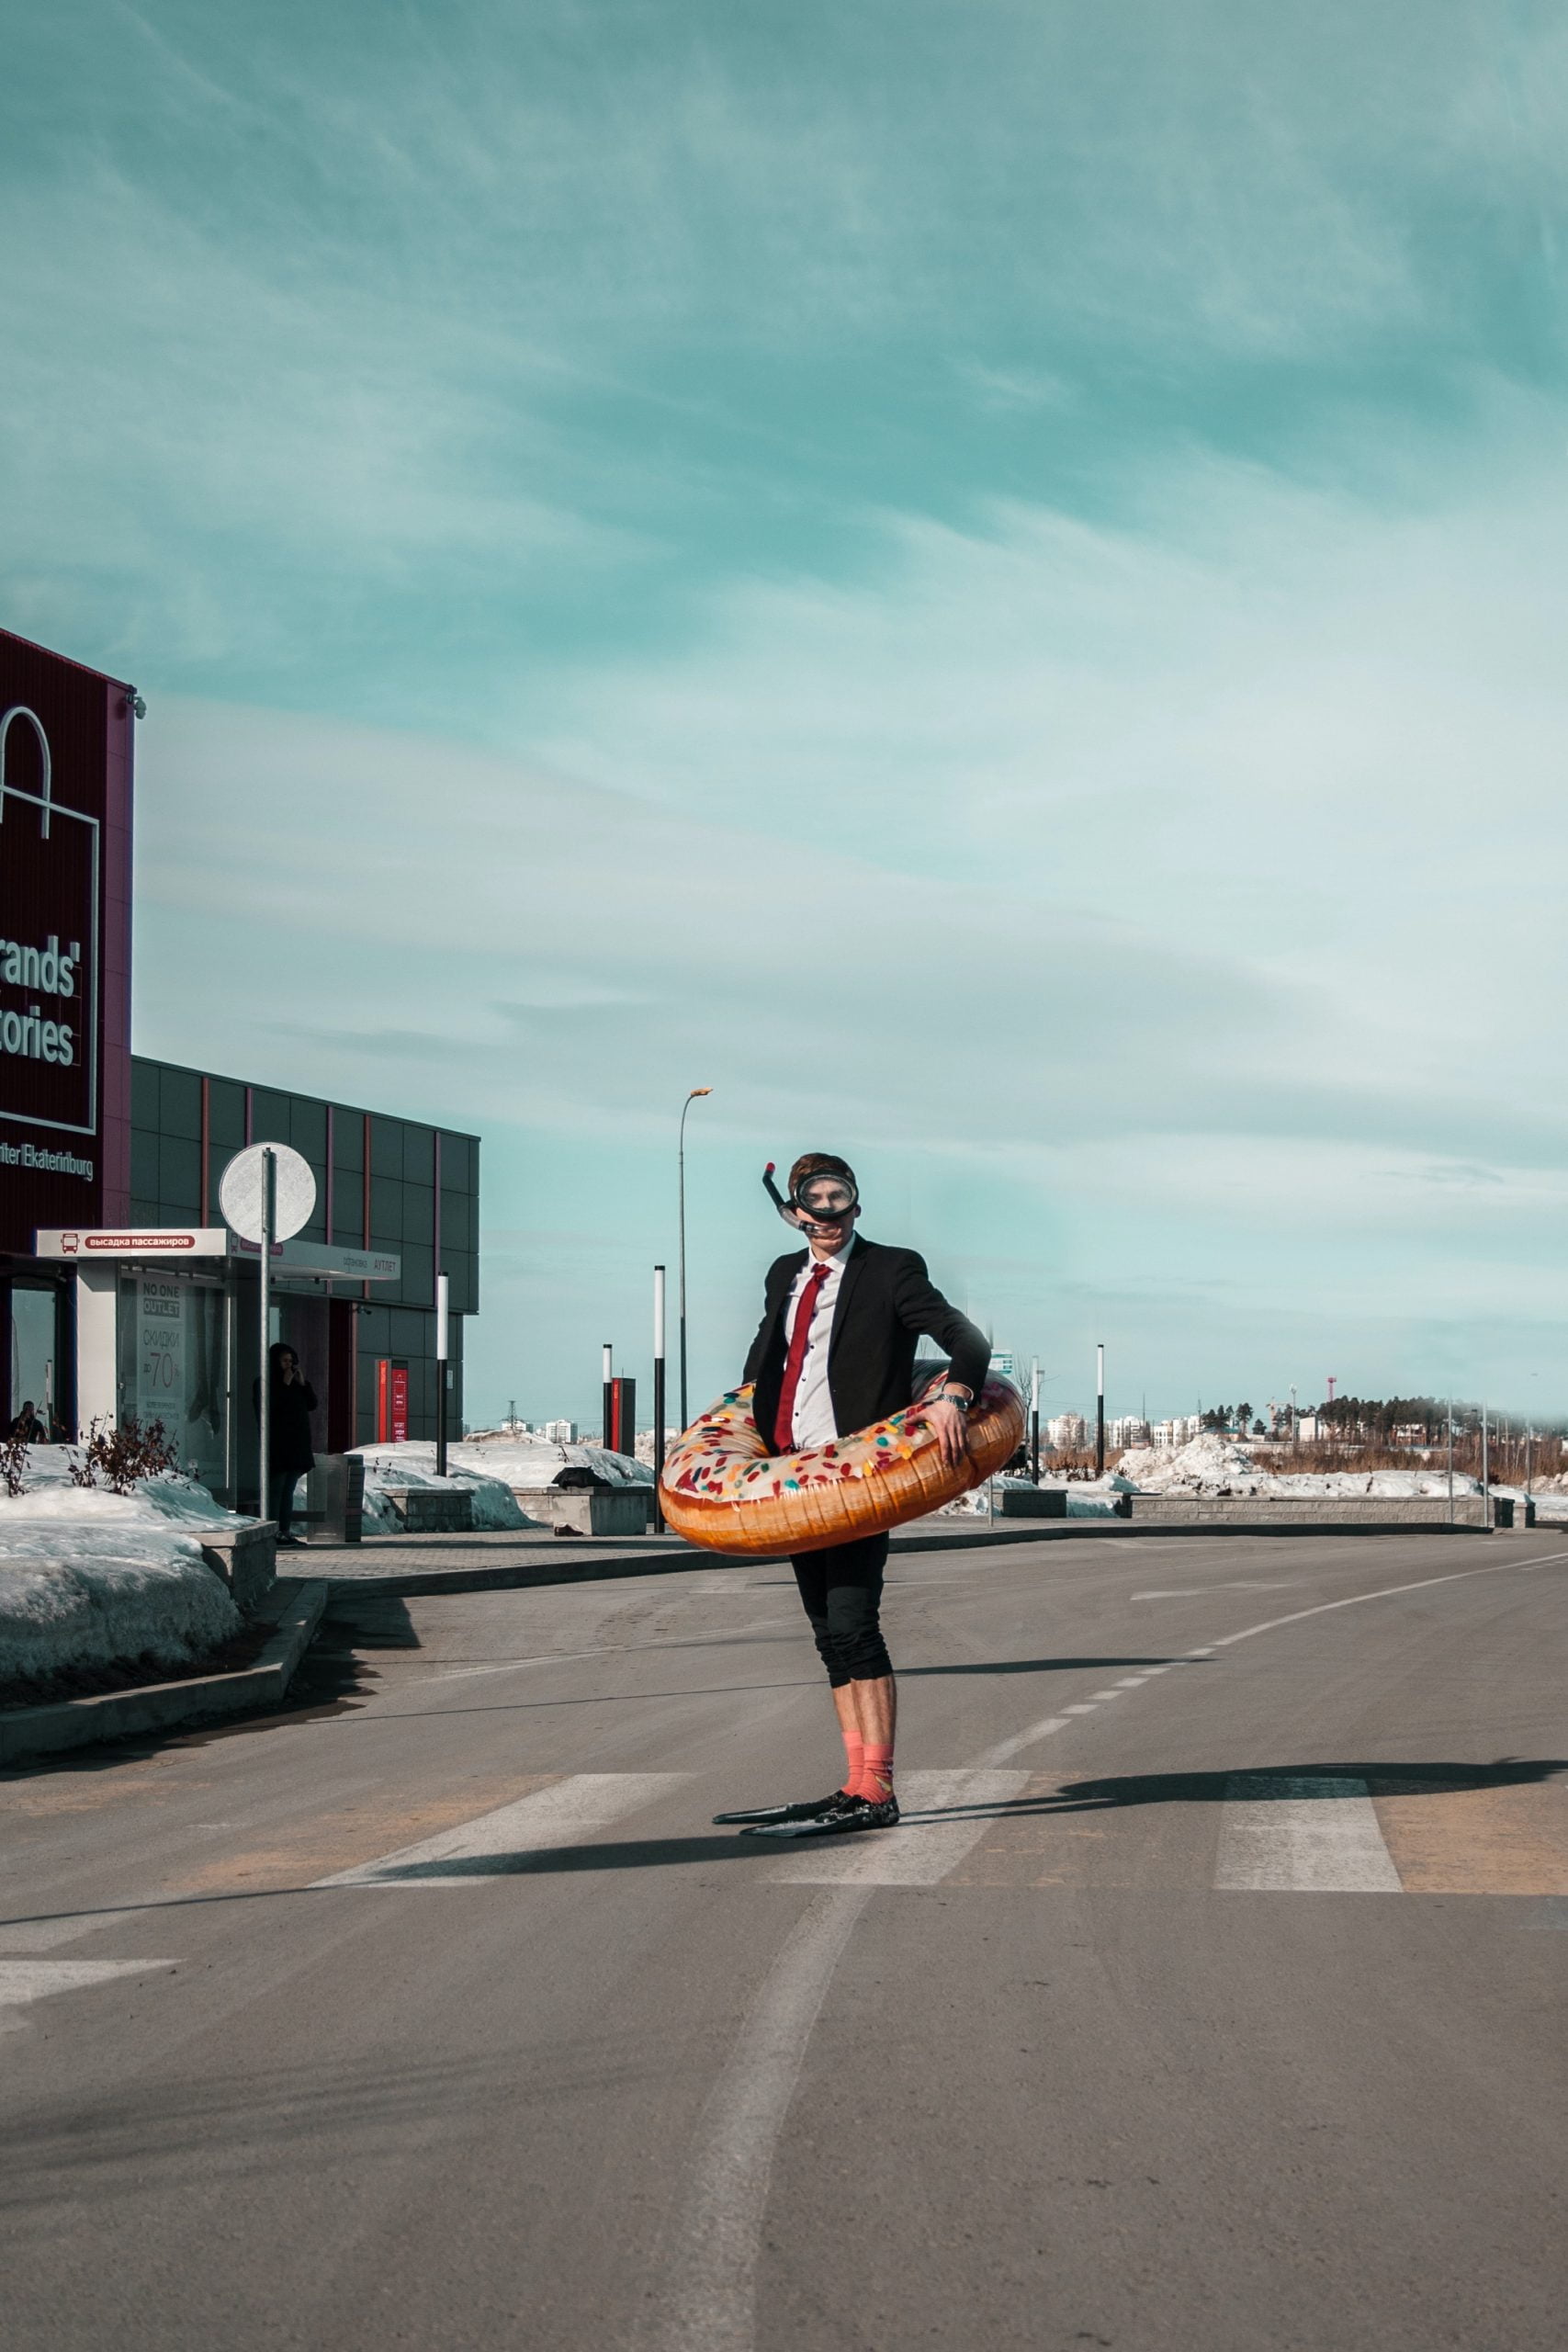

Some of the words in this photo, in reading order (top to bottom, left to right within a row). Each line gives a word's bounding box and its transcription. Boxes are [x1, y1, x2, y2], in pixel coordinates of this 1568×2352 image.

[0, 1005, 74, 1067] ories
[21, 1144, 93, 1182] Ekaterinburg
[89, 1238, 130, 1247] высадка
[131, 1238, 190, 1247] пассажиров
[374, 1258, 397, 1272] АУТЛЕТ
[143, 1283, 157, 1295] NO
[159, 1284, 180, 1298] ONE
[144, 1299, 179, 1315] OUTLET
[143, 1329, 180, 1350] СКИДКИ
